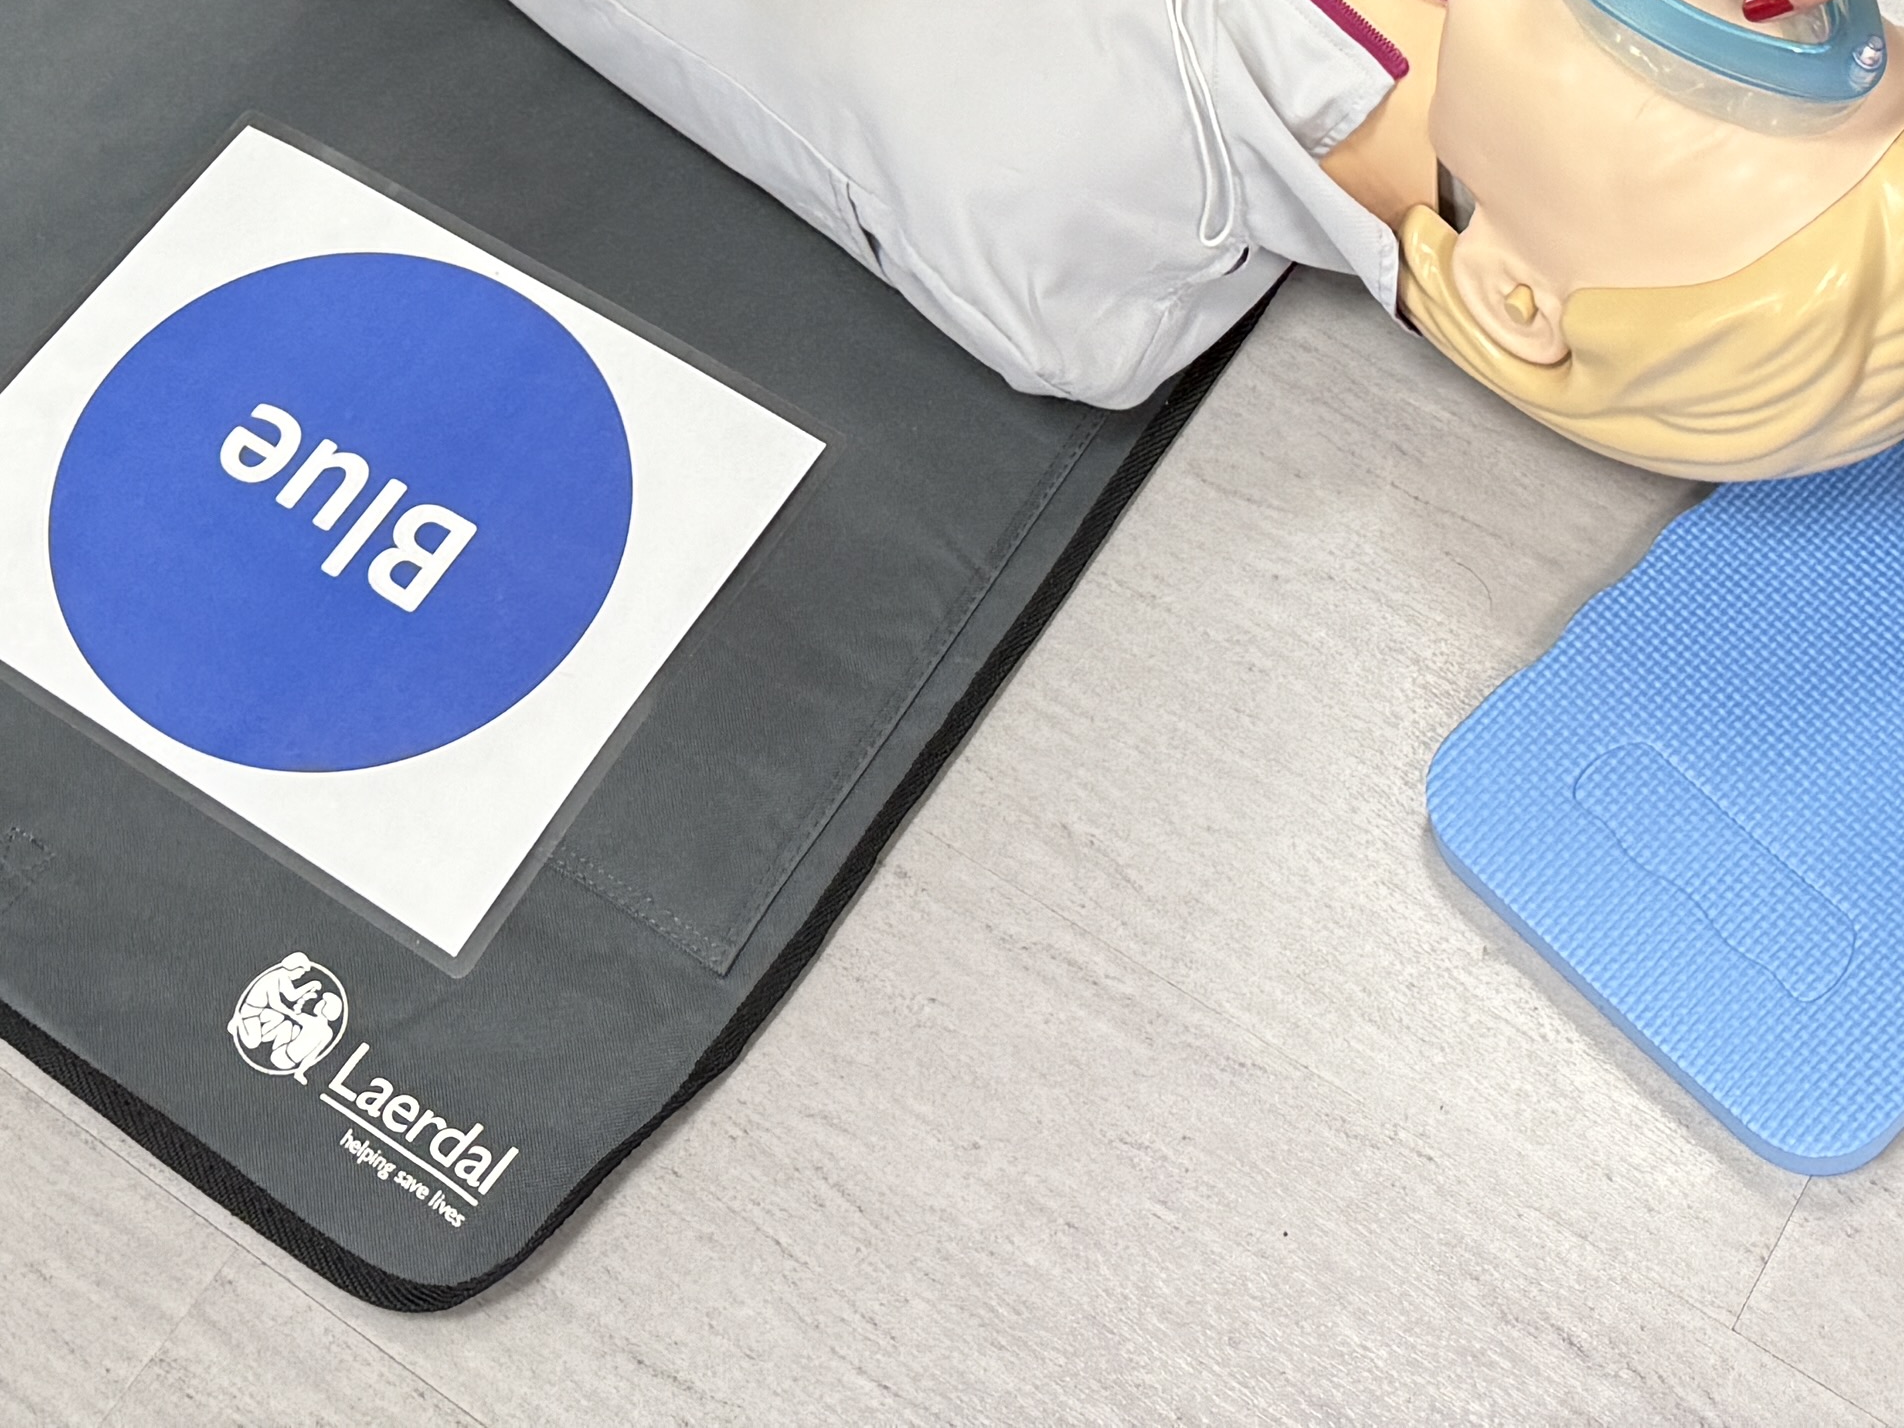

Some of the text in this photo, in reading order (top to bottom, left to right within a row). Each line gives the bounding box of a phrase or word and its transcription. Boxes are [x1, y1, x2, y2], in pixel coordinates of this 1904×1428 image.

[219, 402, 478, 613] Blue
[328, 1042, 520, 1196] Laerdal
[339, 1128, 466, 1228] helping save lives
